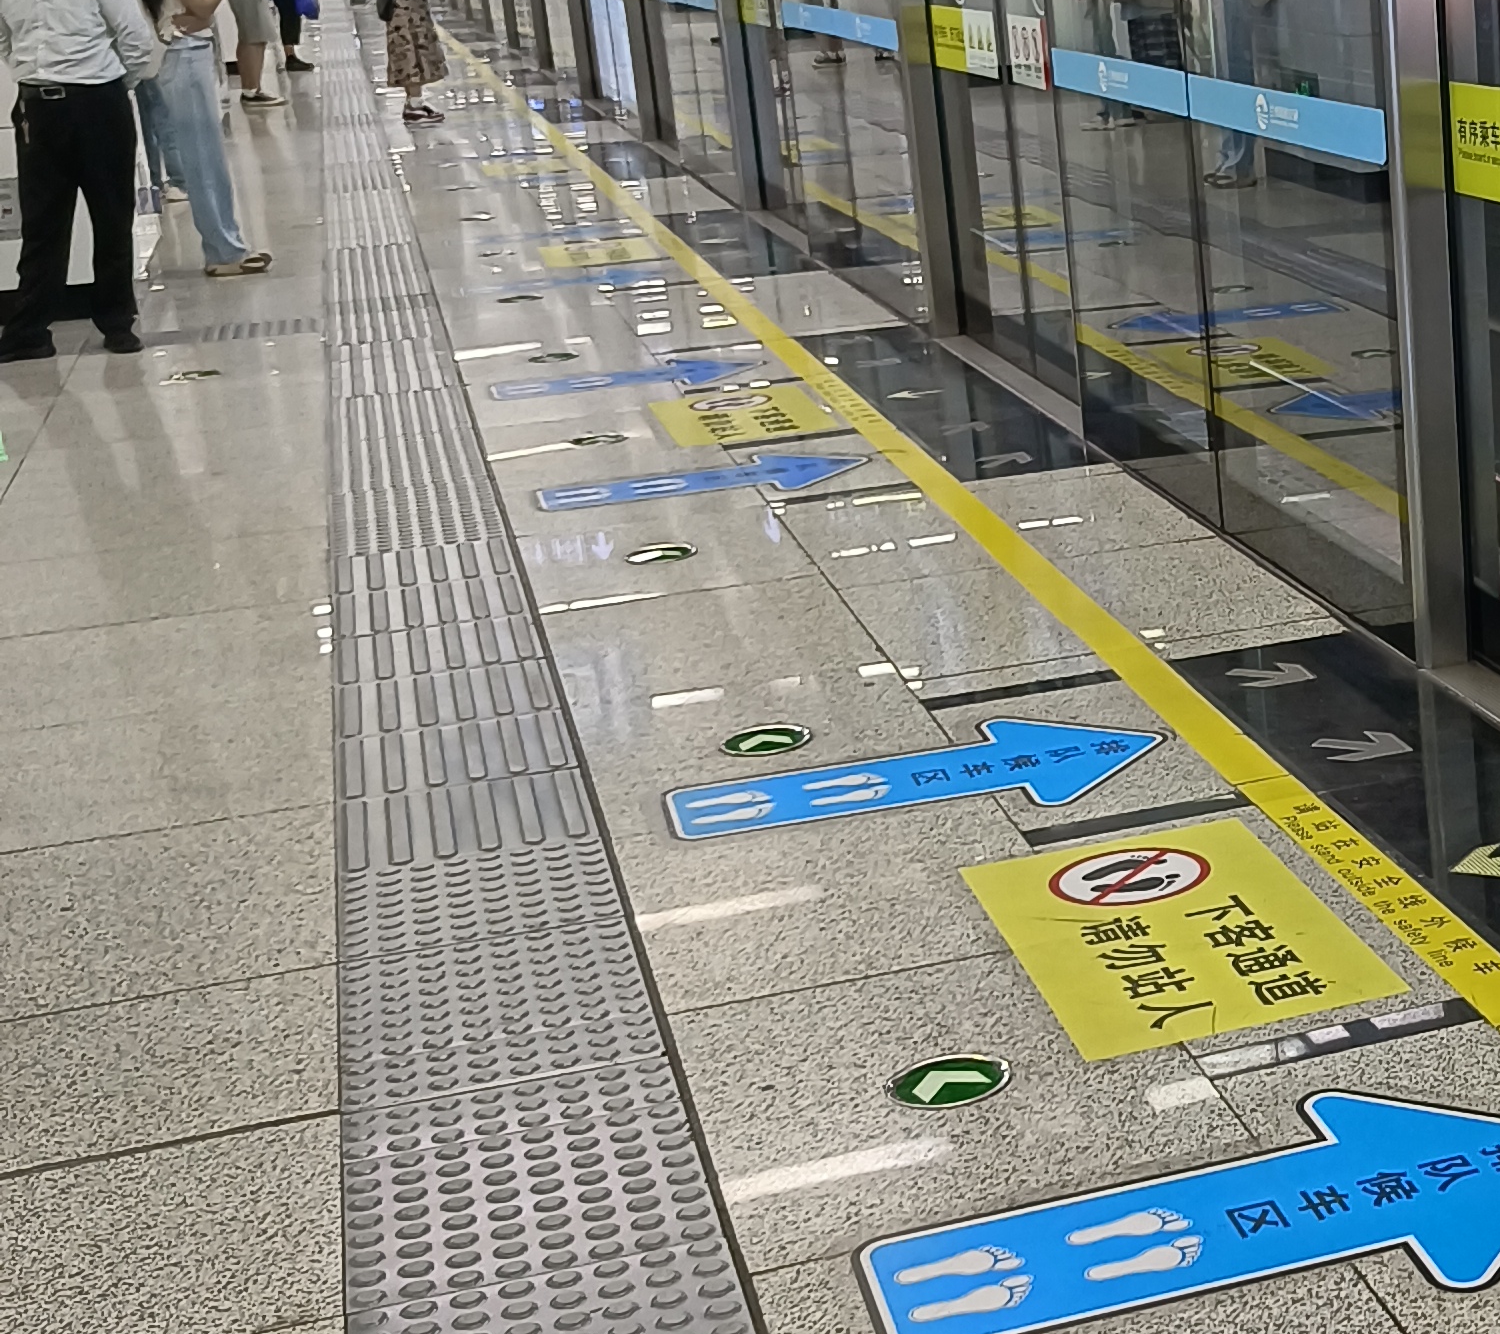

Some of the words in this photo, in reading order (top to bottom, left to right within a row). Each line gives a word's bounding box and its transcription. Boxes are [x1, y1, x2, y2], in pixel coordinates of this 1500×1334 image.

[1457, 118, 1500, 152] 有序乘车
[1185, 893, 1329, 1006] 下客通道
[1311, 844, 1344, 865] stand
[1373, 899, 1396, 916] the
[1393, 918, 1431, 946] safety
[1427, 948, 1454, 968] line
[1080, 915, 1214, 1031] 请勿站人
